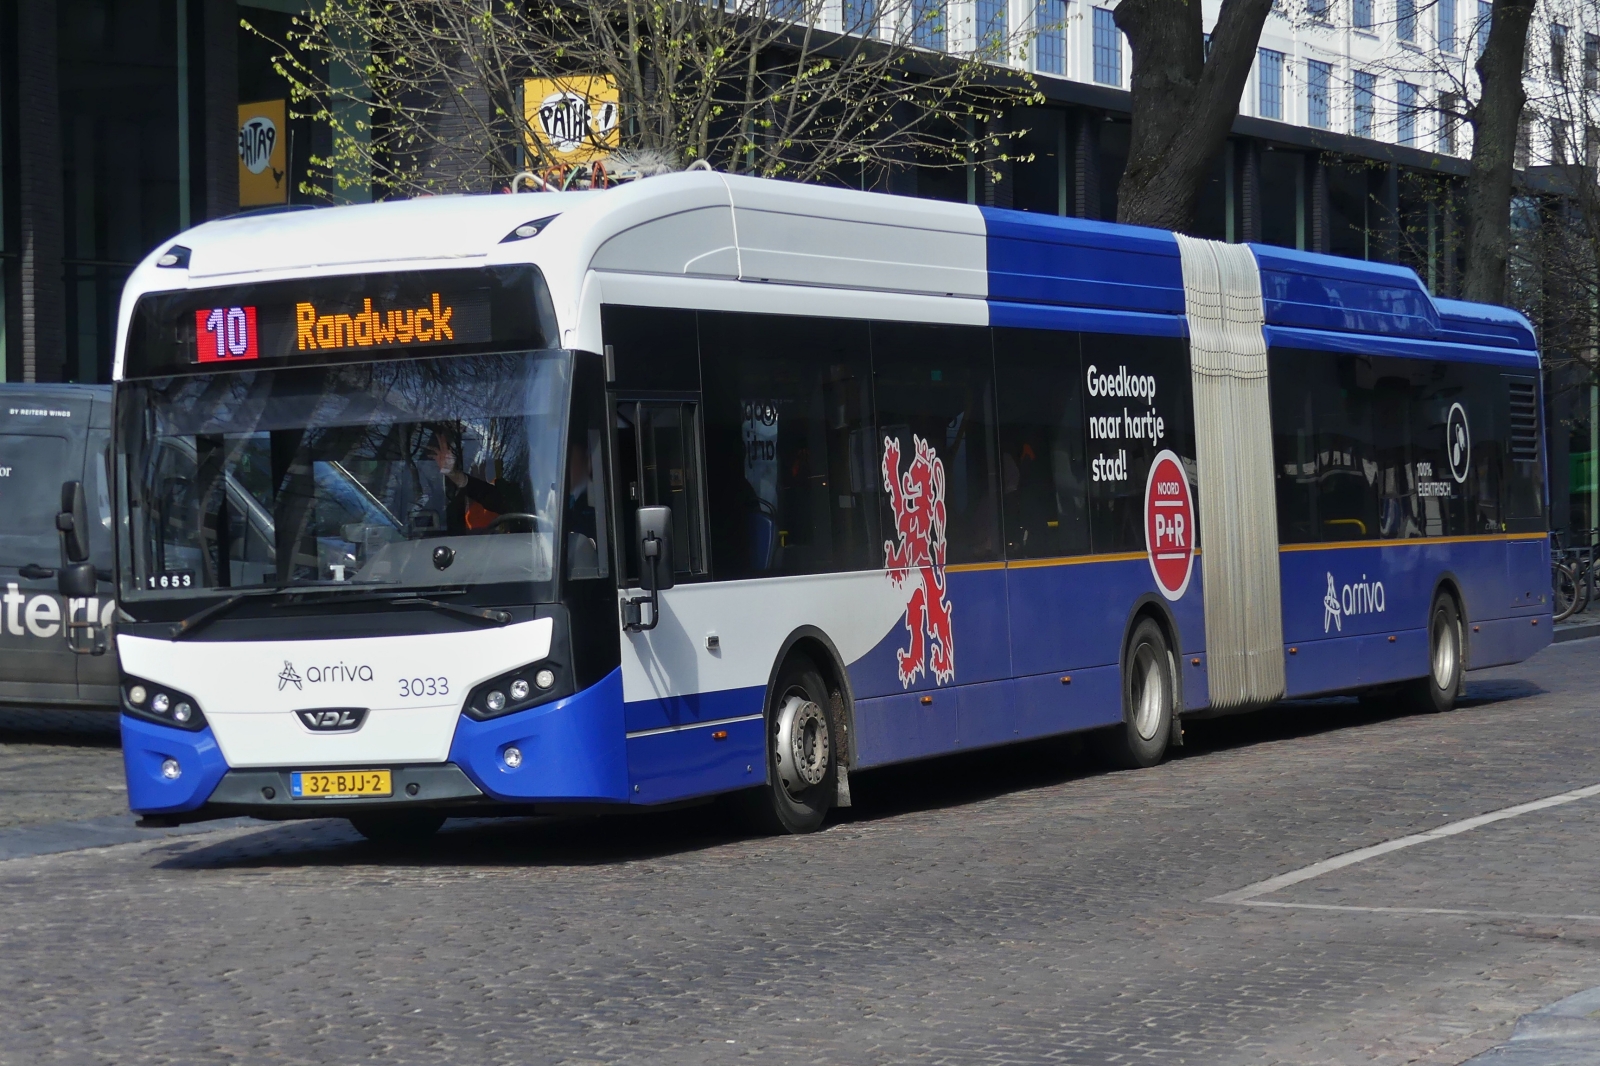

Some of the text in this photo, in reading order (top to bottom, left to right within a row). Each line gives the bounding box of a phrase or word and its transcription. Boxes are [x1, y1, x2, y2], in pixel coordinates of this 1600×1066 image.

[207, 292, 453, 356] 10 Randwyck
[1087, 364, 1156, 406] Goedkoop
[20, 408, 48, 417] REITERS
[49, 410, 71, 418] WINGS
[1089, 407, 1165, 447] naar hartje
[1092, 448, 1128, 482] stad!
[1416, 462, 1433, 477] 100%
[1157, 481, 1180, 496] NOORD
[1418, 481, 1452, 497] ELEKTRISCH
[1155, 513, 1186, 548] P+R
[149, 574, 191, 588] 1653
[1342, 573, 1386, 616] arriva
[306, 660, 374, 683] arriva
[398, 676, 450, 698] 3033
[304, 711, 356, 727] VDL
[310, 774, 382, 793] 32-BJJ-2
